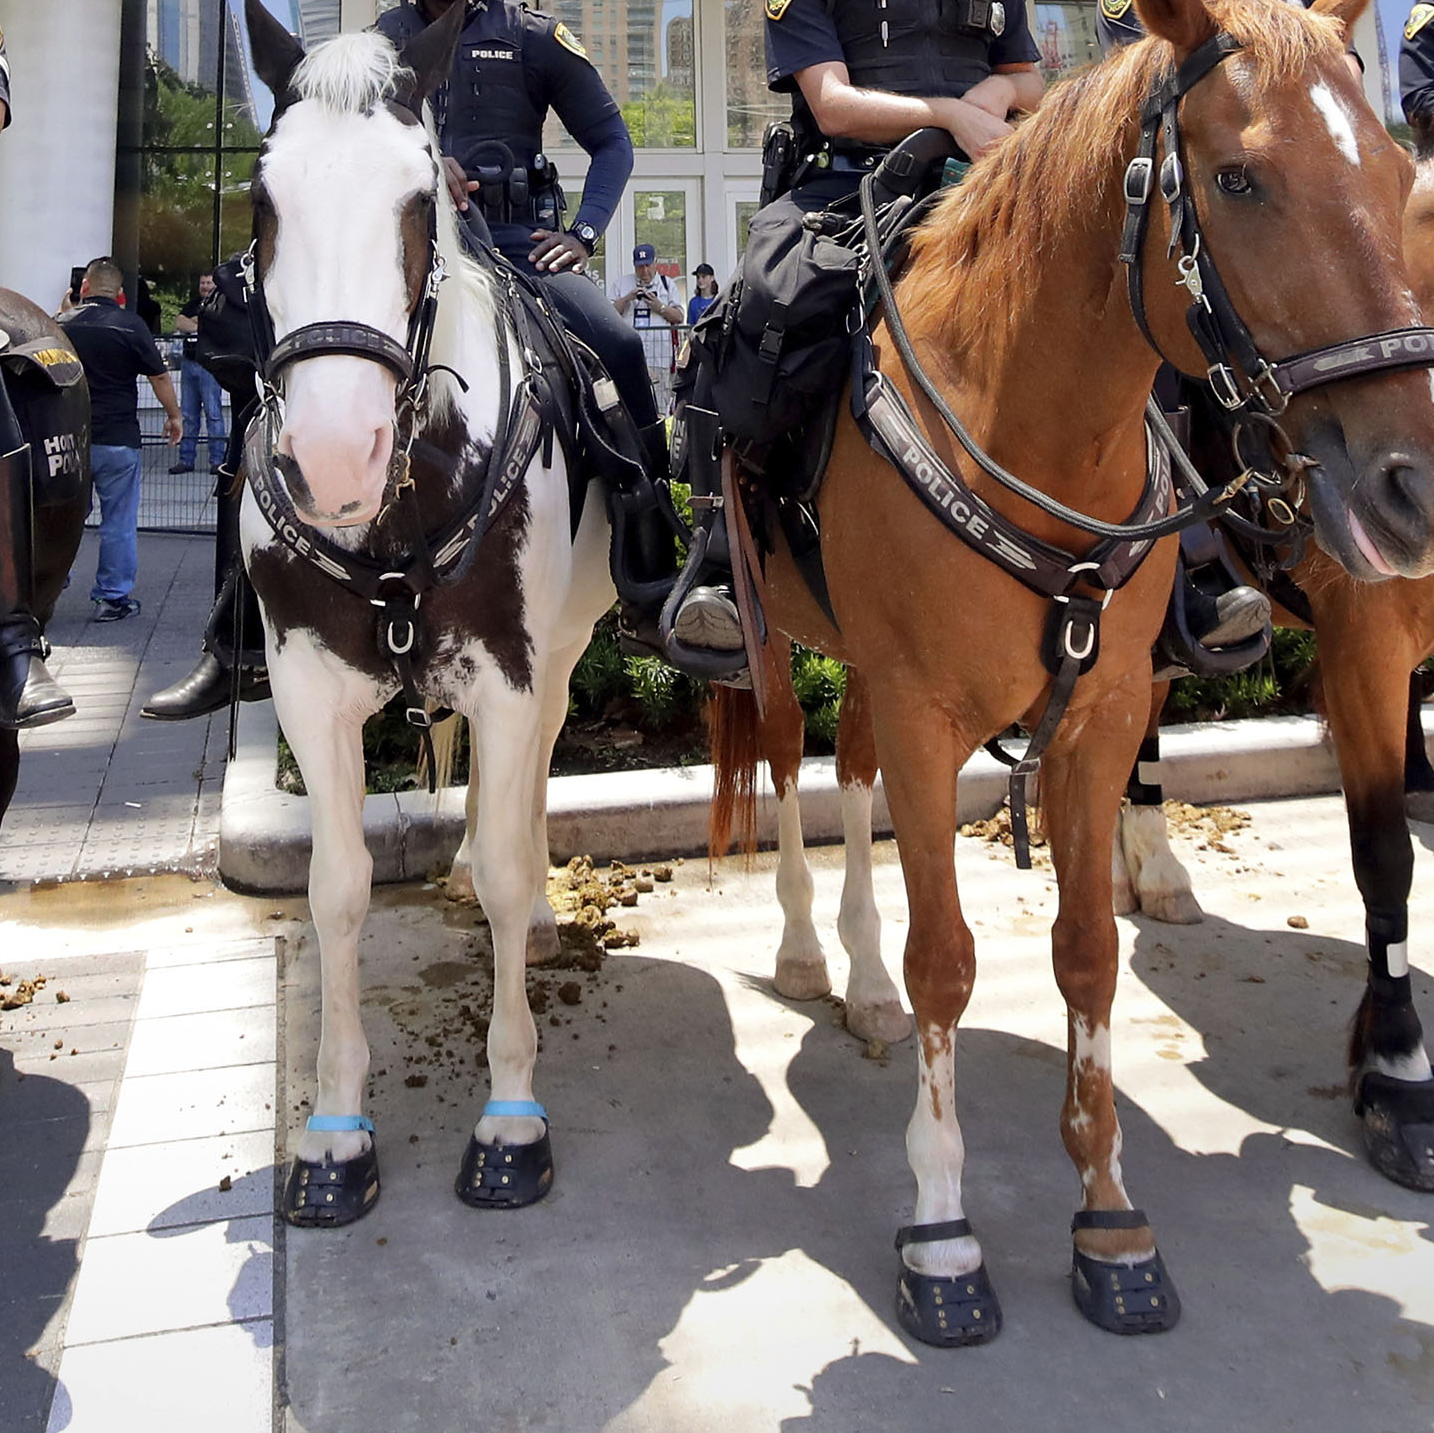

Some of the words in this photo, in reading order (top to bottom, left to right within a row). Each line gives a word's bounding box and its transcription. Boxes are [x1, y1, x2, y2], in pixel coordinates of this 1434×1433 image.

[471, 50, 514, 59] POLICE
[253, 474, 312, 556] POLICE
[903, 446, 989, 540] POLICE
